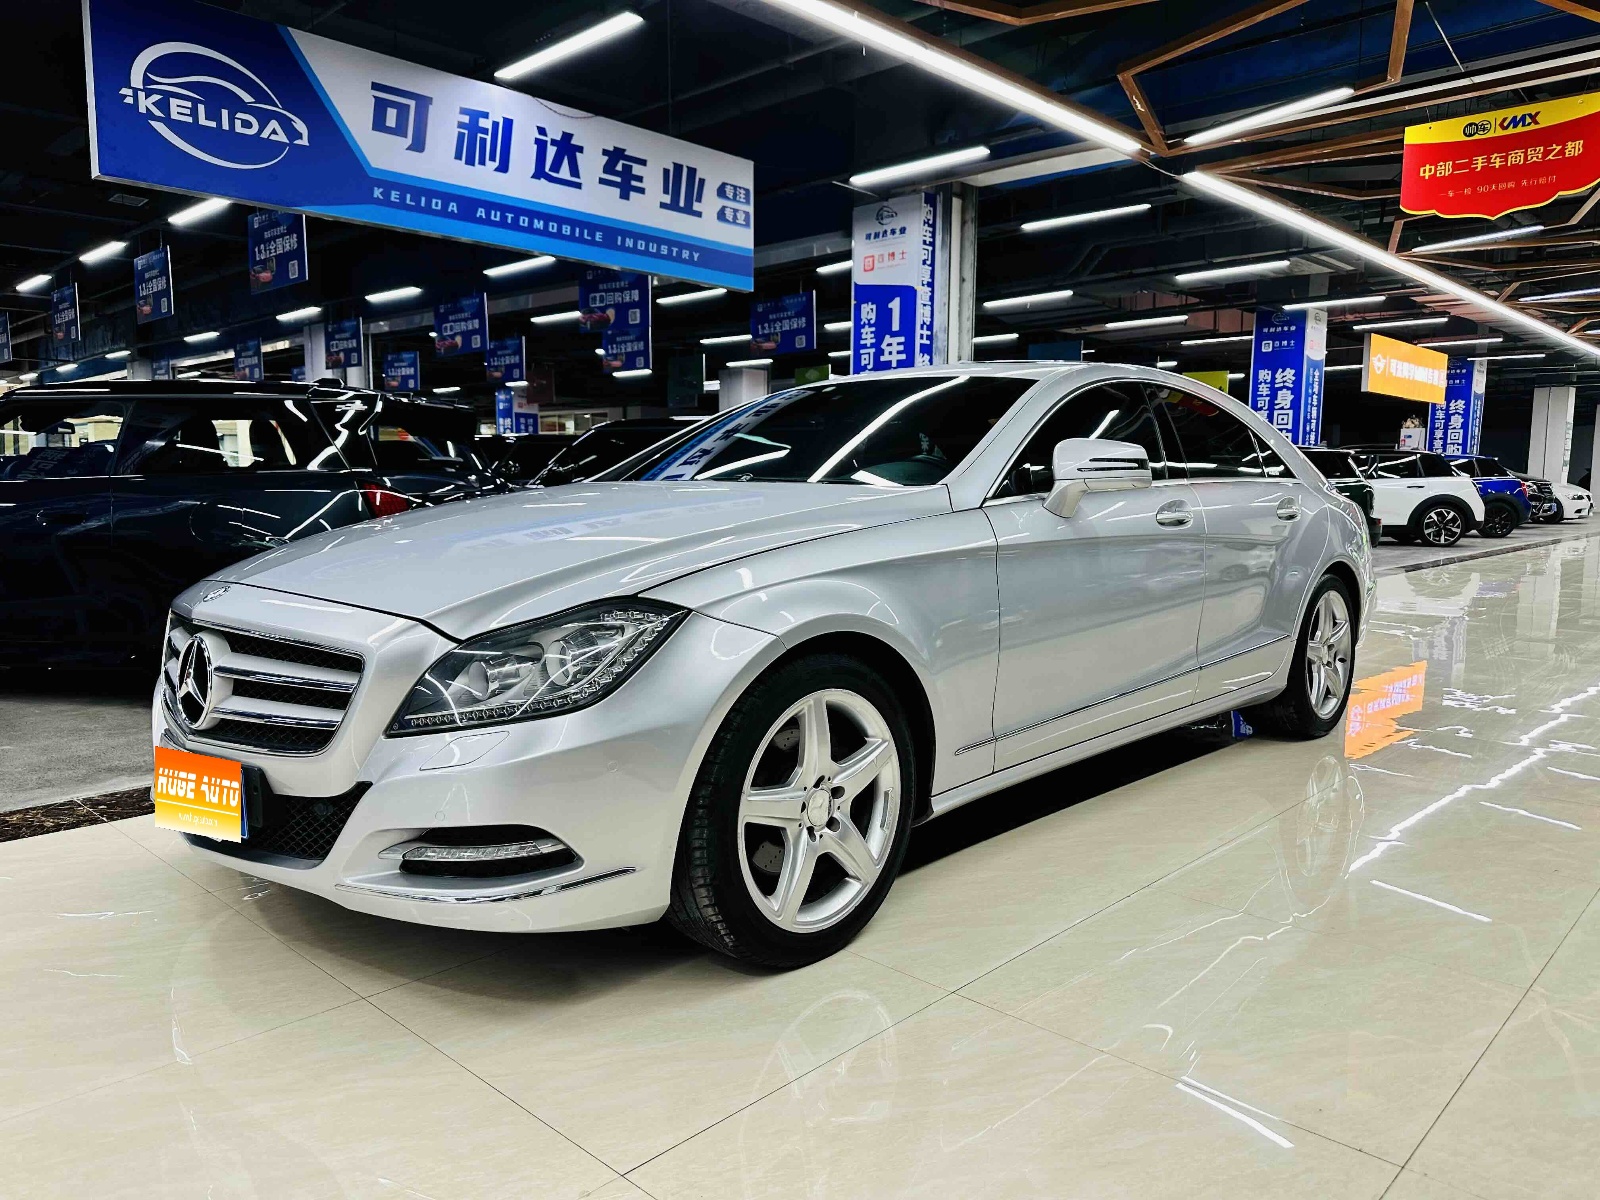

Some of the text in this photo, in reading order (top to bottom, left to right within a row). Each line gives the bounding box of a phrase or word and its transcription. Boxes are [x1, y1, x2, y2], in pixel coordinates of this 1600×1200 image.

[137, 90, 291, 144] KELIDA
[370, 81, 706, 218] 可利达车业
[1419, 139, 1584, 180] 中部二手车商贸之都
[724, 184, 747, 203] 专注
[724, 207, 747, 225] 专业
[372, 186, 700, 262] KELIDA AUTOMOBILE INDUSTRY
[859, 302, 877, 374] 购车可
[1445, 399, 1467, 455] 终身回购
